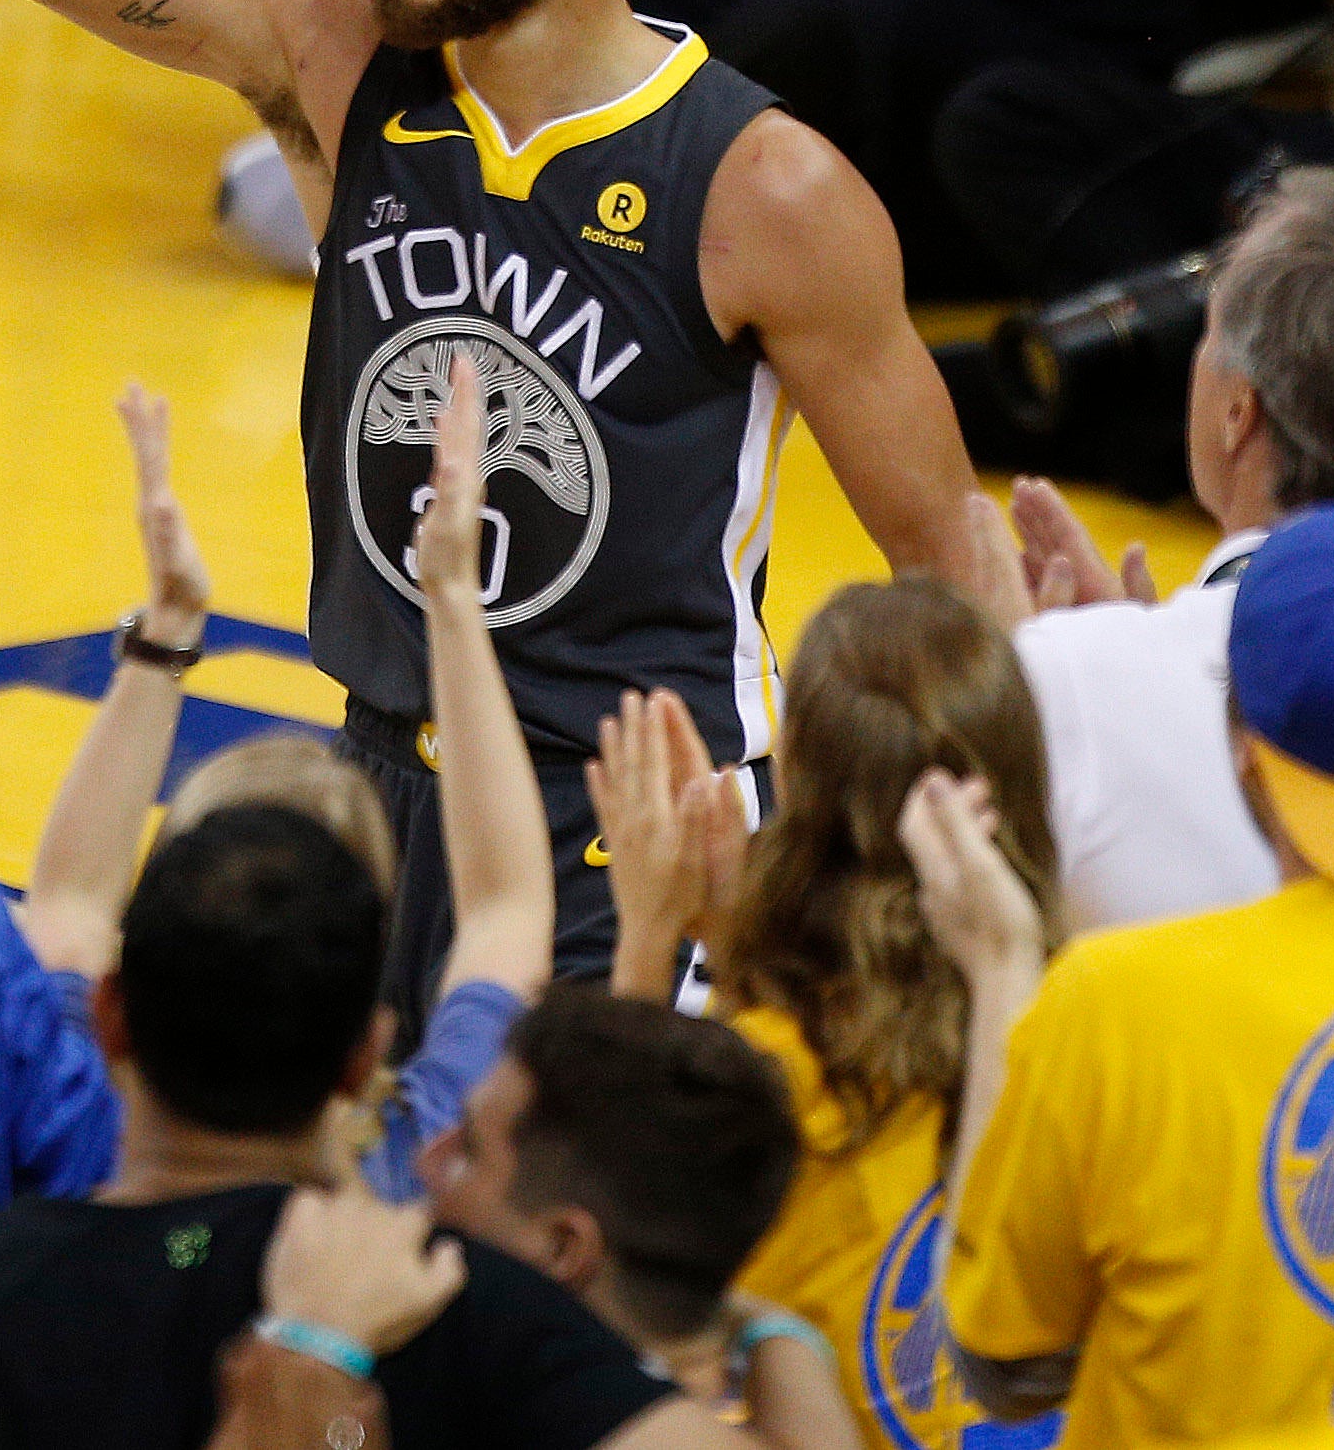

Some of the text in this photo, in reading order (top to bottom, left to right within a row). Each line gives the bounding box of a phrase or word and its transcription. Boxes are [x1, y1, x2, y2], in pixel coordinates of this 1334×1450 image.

[611, 193, 631, 223] R
[580, 225, 645, 254] Rakuten
[346, 226, 642, 401] TOWN
